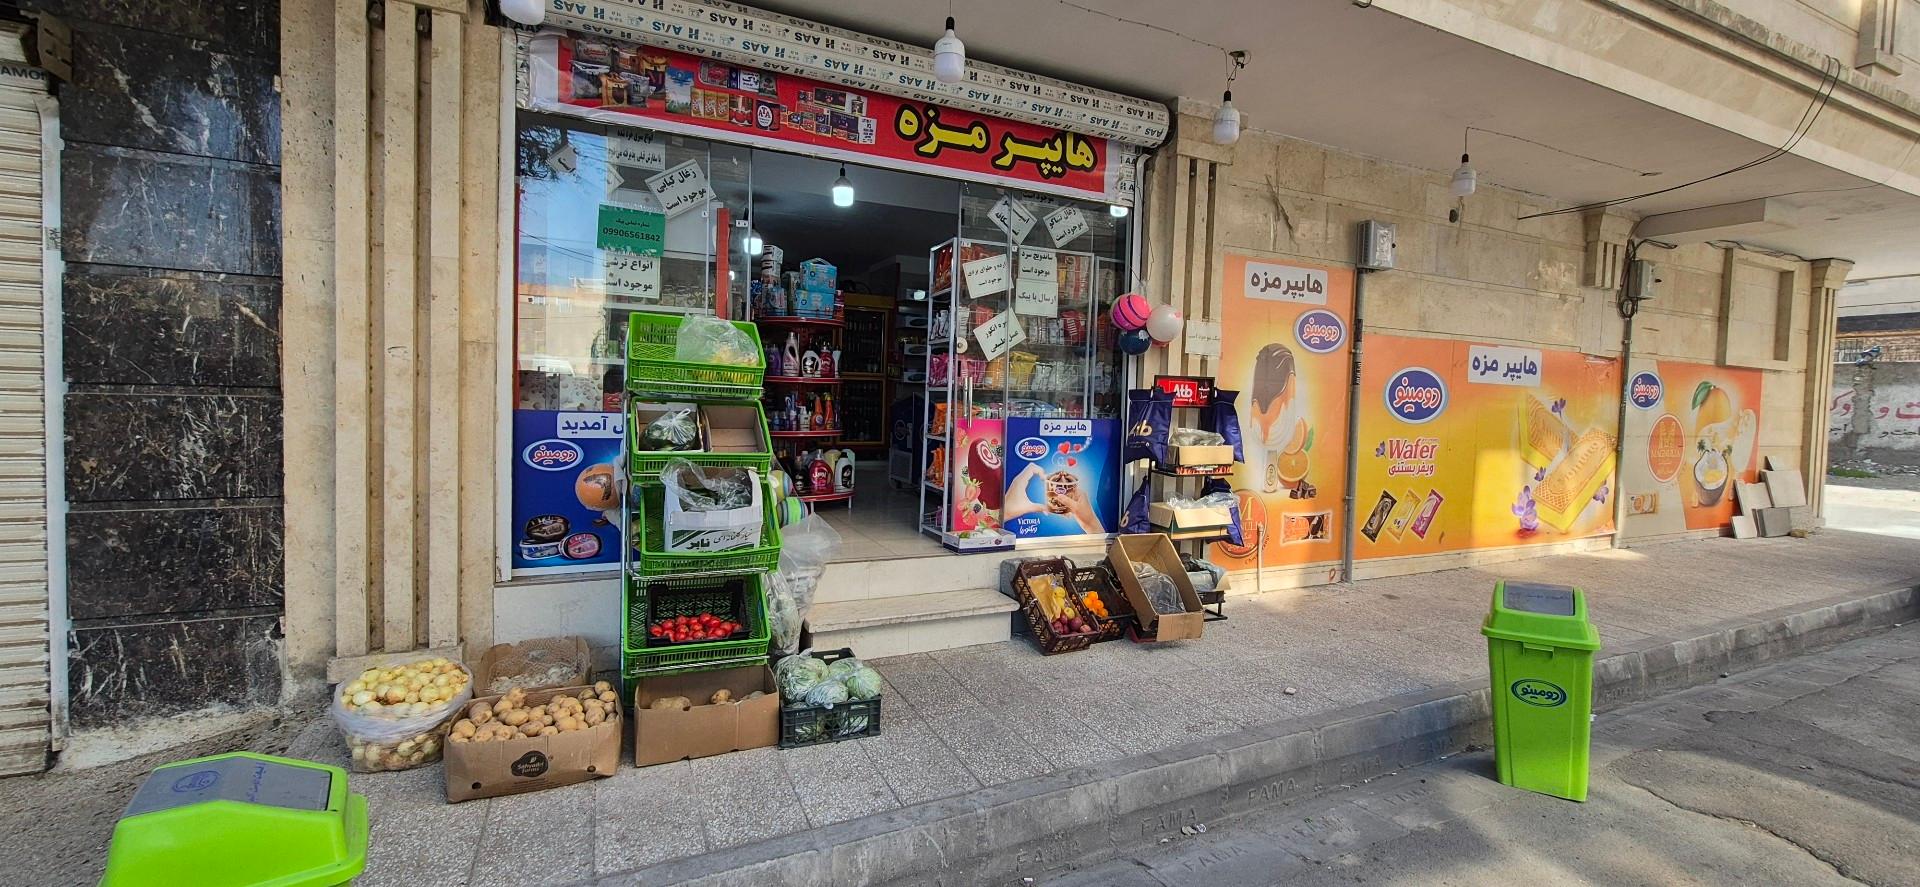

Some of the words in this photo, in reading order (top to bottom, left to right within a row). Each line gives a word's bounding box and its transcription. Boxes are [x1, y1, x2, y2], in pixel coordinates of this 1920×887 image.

[897, 108, 988, 155] مزه
[996, 133, 1095, 175] هایپر
[678, 168, 697, 183] زغال
[665, 196, 682, 209] است
[683, 187, 706, 203] موجود
[602, 227, 660, 242] 09906561842
[1056, 231, 1068, 242] است
[1067, 222, 1084, 235] موجود
[1021, 251, 1033, 259] سرد
[1033, 251, 1053, 261] ساندویچ
[630, 260, 653, 272] انواع
[1034, 268, 1051, 277] موجود
[624, 279, 653, 292] موجود
[1250, 272, 1282, 292] مزه
[1281, 273, 1323, 299] هایپر
[1032, 292, 1038, 303] با
[1038, 293, 1057, 304] ارسال
[1302, 322, 1339, 350] دومینو
[1472, 356, 1498, 376] مزه
[1502, 358, 1538, 382] هایپر
[1393, 376, 1440, 412] دومینو
[1632, 376, 1661, 403] دومینو
[561, 415, 607, 435] آمدید
[1043, 423, 1061, 434] مزه
[1064, 422, 1087, 434] هایپر
[533, 443, 578, 466] دومینو
[1020, 441, 1048, 461] دومینو
[1389, 439, 1438, 460] Wafer
[1389, 461, 1416, 477] بستنی
[1416, 461, 1434, 476] ویفر
[1521, 685, 1560, 701] دومینو
[1248, 777, 1296, 805] FAMA
[1142, 807, 1198, 837] FAMA
